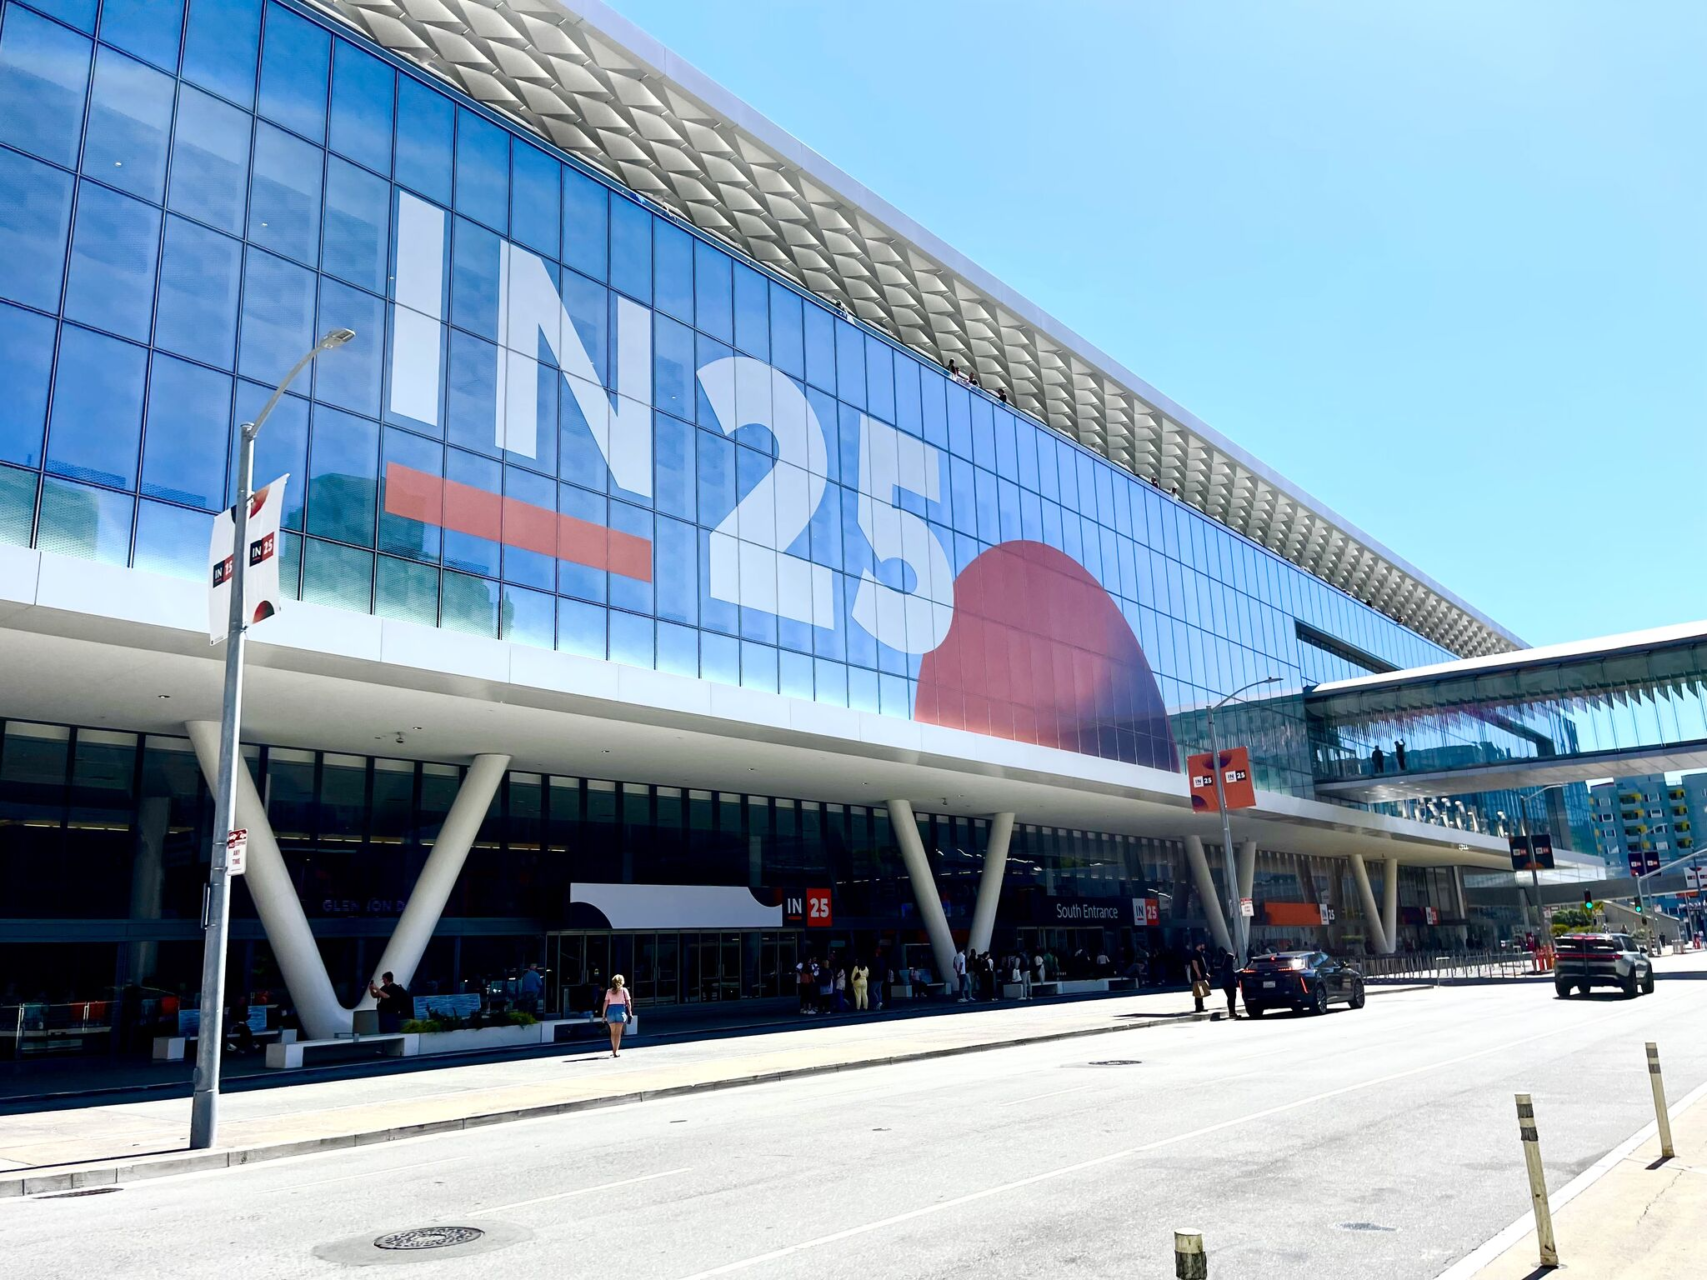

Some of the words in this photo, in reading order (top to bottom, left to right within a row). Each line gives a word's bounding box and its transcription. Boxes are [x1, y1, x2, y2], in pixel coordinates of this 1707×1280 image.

[390, 190, 652, 498] IN
[696, 355, 955, 655] 25
[252, 546, 261, 558] IN
[263, 539, 273, 555] 25
[215, 567, 223, 579] IN
[787, 898, 802, 914] IN
[809, 897, 830, 918] 25
[1056, 903, 1082, 919] South
[1083, 904, 1119, 919] Entrance
[1135, 905, 1144, 917] IN
[1146, 905, 1158, 920] 25
